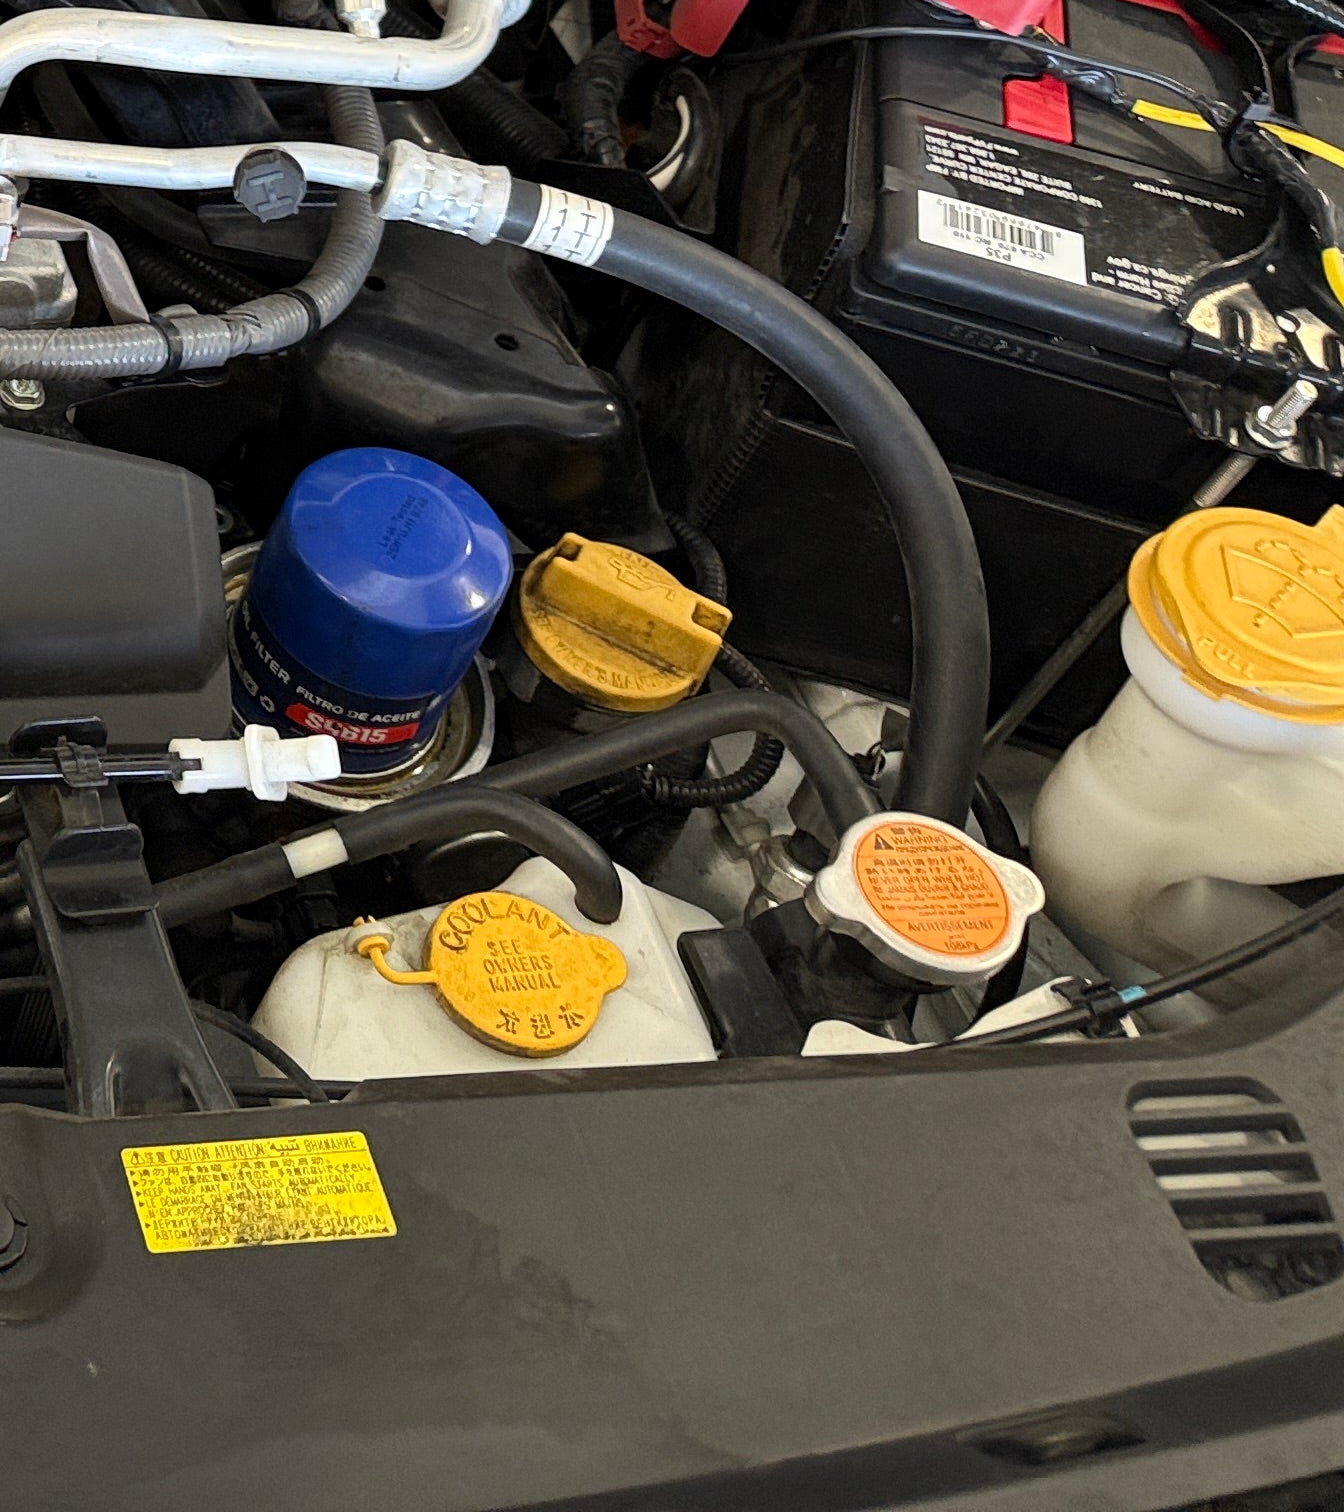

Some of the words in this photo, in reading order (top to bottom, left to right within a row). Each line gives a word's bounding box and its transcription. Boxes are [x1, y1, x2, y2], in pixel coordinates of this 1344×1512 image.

[1130, 180, 1184, 201] BATTERY
[984, 246, 1012, 261] P35
[1198, 636, 1256, 679] PULL
[250, 631, 291, 685] FILTER
[296, 685, 344, 716] FILTRO
[370, 710, 422, 724] ACEITE
[439, 898, 571, 951] COOLANT
[487, 938, 522, 957] SEE
[483, 954, 554, 975] OWNERS
[488, 973, 562, 993] MANUAL
[169, 1147, 211, 1162] CAUTION
[215, 1143, 265, 1159] ATTENTION
[304, 1136, 357, 1153] ВНИМАНИЕ
[143, 1187, 163, 1197] KEEP
[169, 1185, 195, 1195] HANDS
